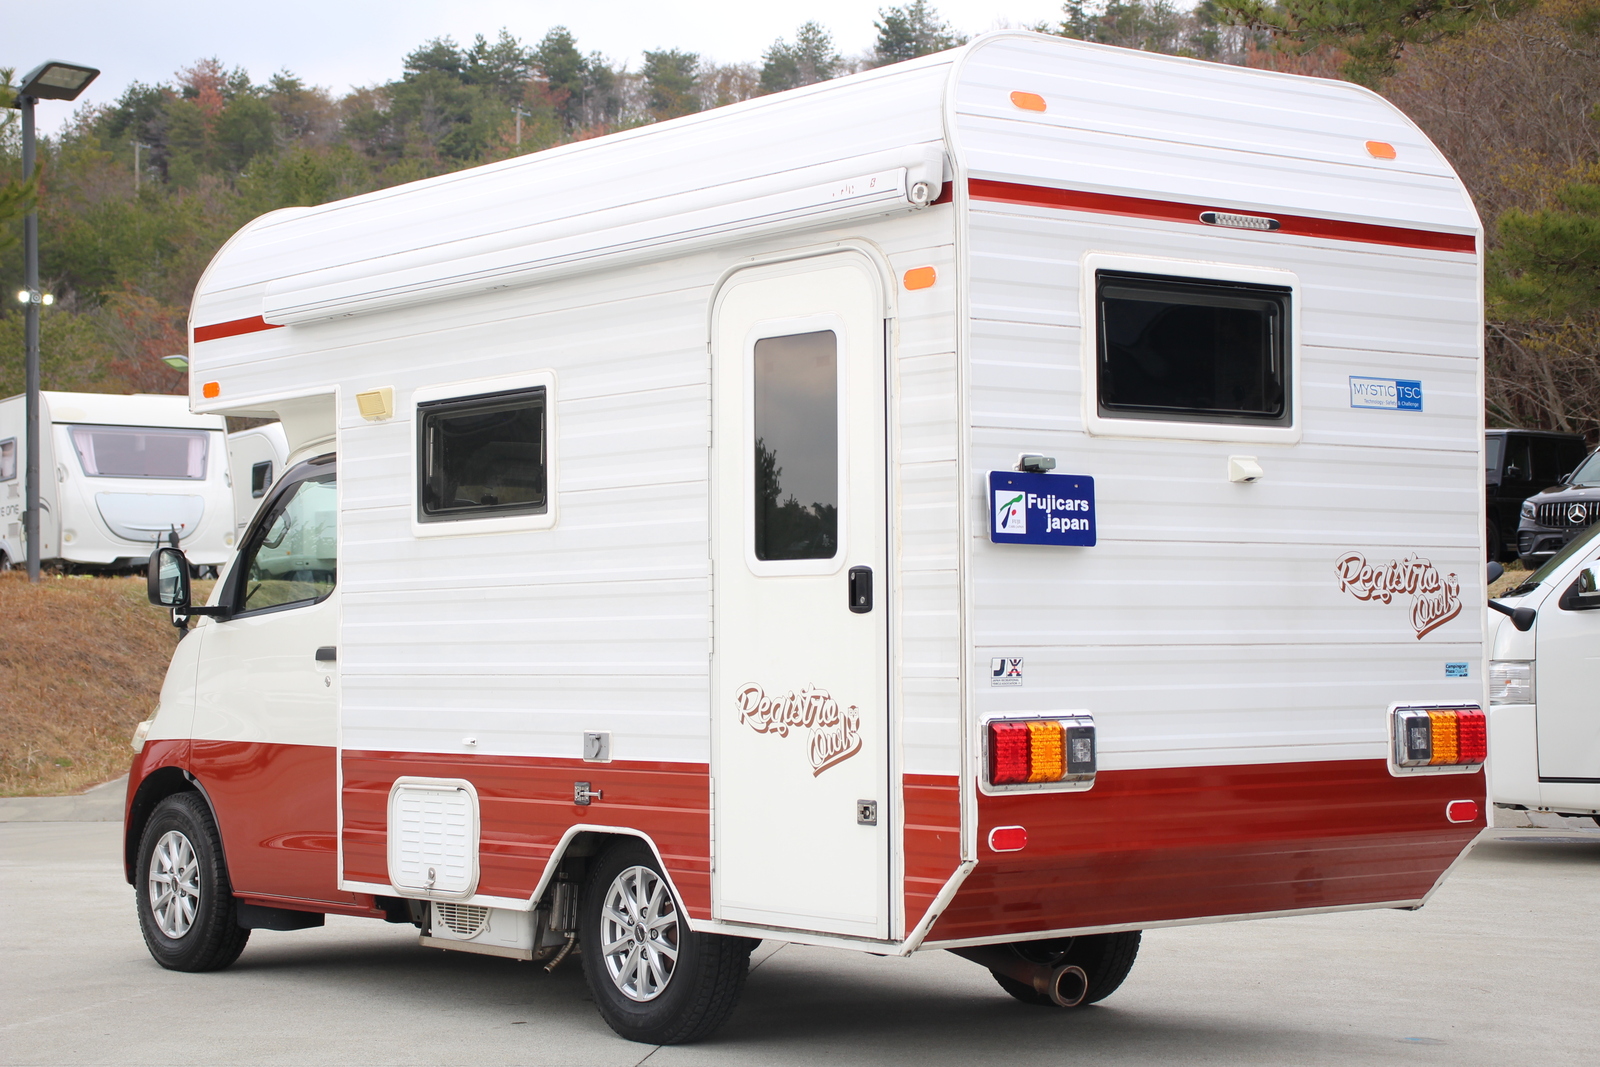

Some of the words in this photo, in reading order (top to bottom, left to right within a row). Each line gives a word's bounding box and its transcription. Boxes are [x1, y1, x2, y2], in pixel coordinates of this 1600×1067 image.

[1354, 384, 1395, 397] MYSTIC
[1396, 386, 1421, 399] TSC
[1027, 493, 1089, 513] Fujicars
[1046, 514, 1089, 533] japan
[1334, 551, 1441, 604] Registro
[735, 682, 839, 738] Registro
